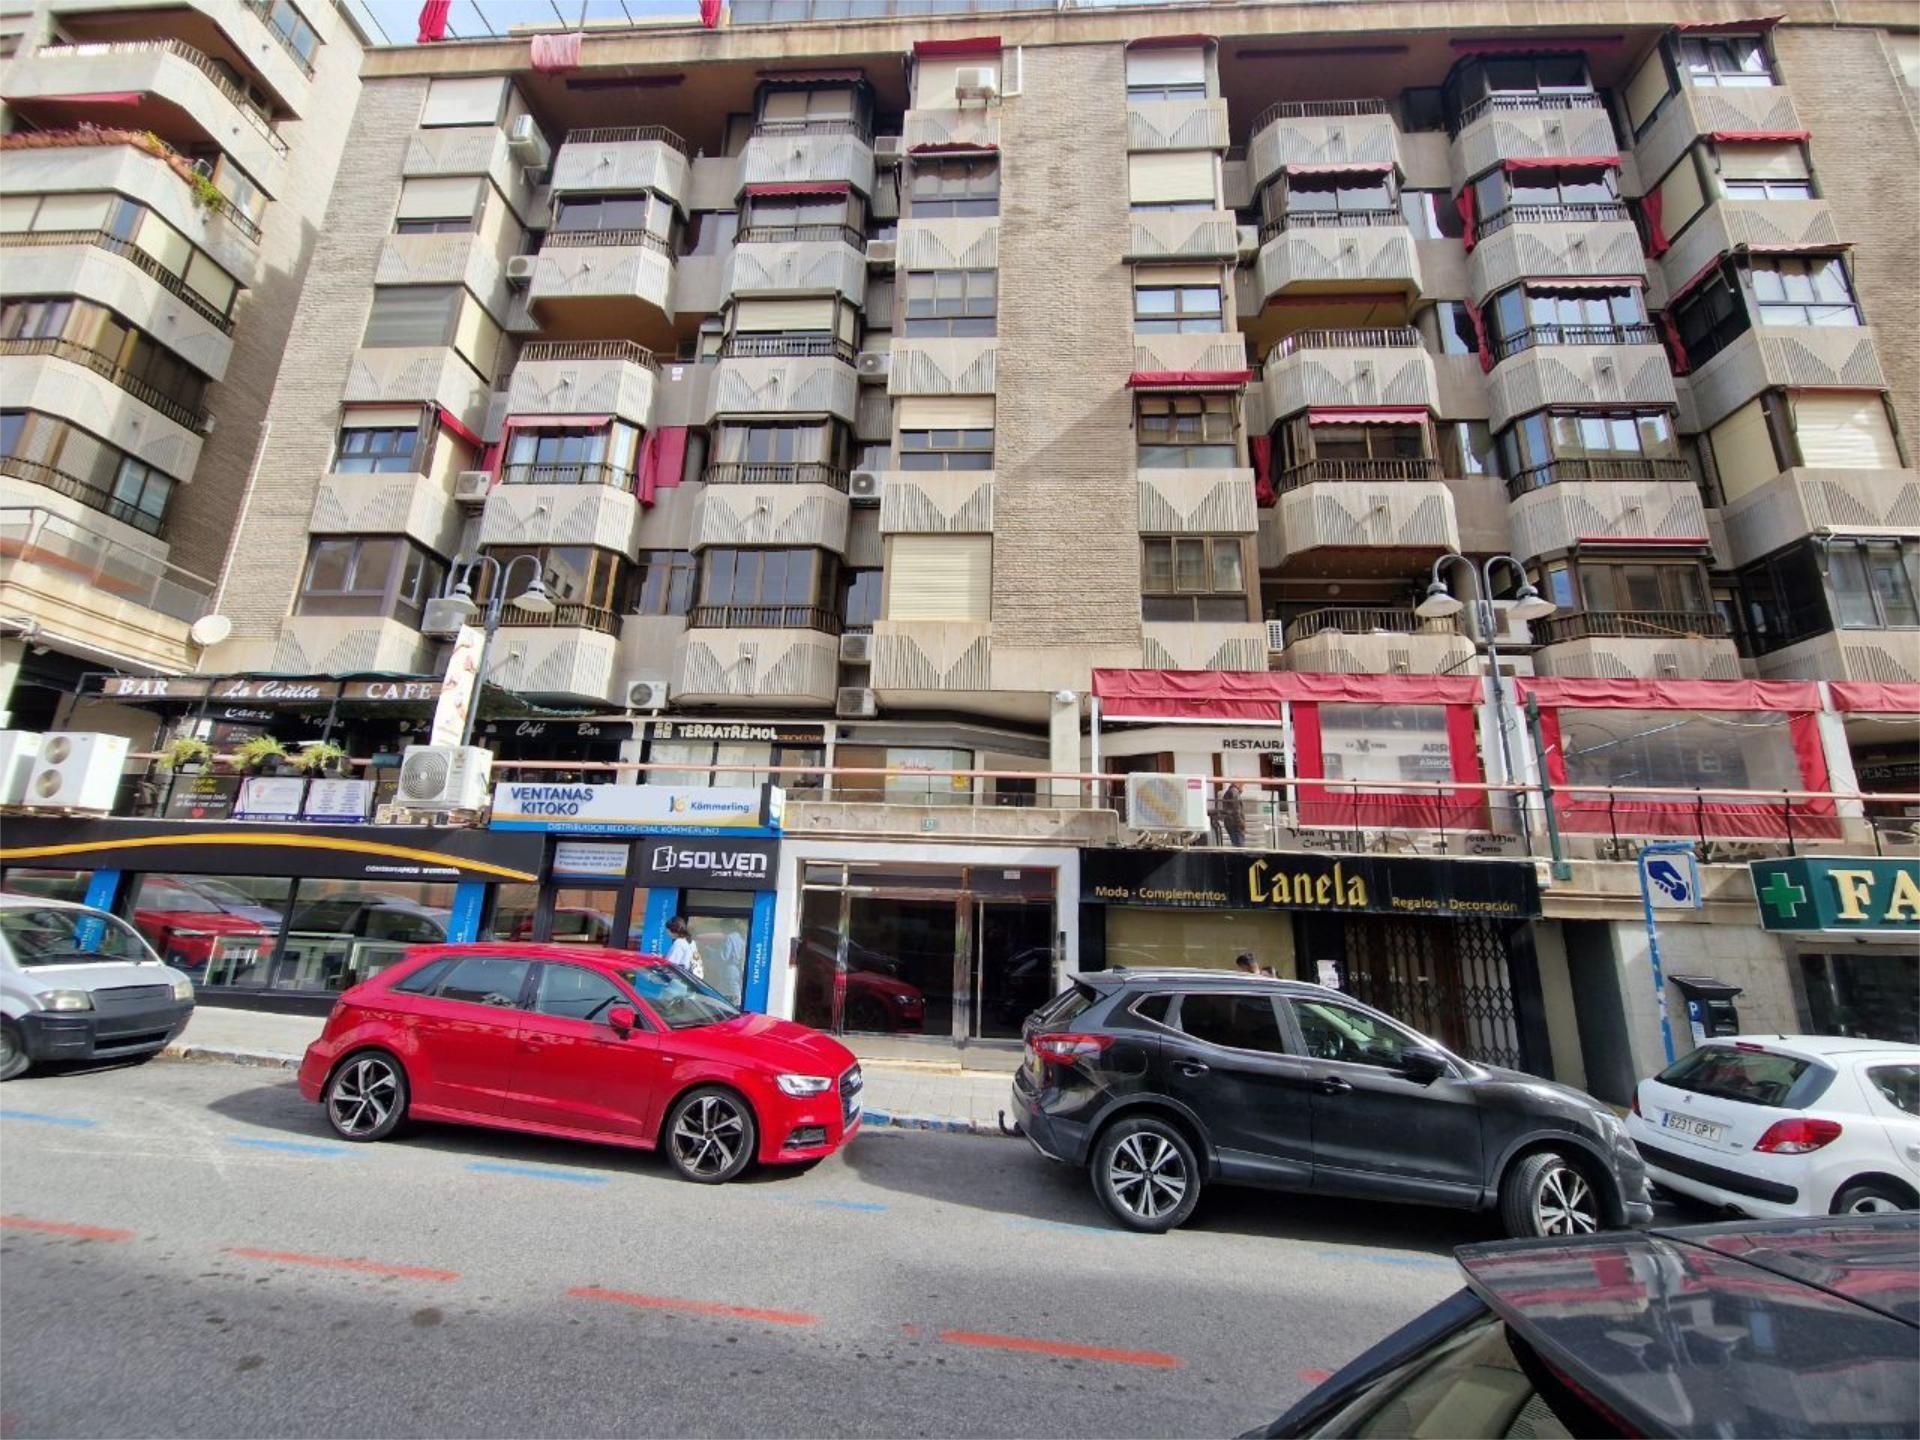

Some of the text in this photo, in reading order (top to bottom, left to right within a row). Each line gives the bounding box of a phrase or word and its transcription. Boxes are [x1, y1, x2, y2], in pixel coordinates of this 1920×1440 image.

[117, 679, 169, 695] BAR
[222, 680, 249, 698] La
[366, 683, 433, 699] CAFE
[515, 721, 547, 739] Café
[577, 723, 601, 736] Bar
[511, 787, 594, 802] VENTANAS
[521, 802, 579, 816] KITOKO
[690, 801, 751, 814] Kömmerling
[679, 851, 768, 871] SOLVEN
[711, 870, 732, 878] Smart
[1248, 859, 1368, 906] Canela
[1095, 886, 1129, 898] Moda
[1139, 887, 1227, 901] Complementos
[1392, 897, 1439, 910] Regalos
[1450, 898, 1518, 912] Decoración
[753, 943, 763, 985] VENTANAS
